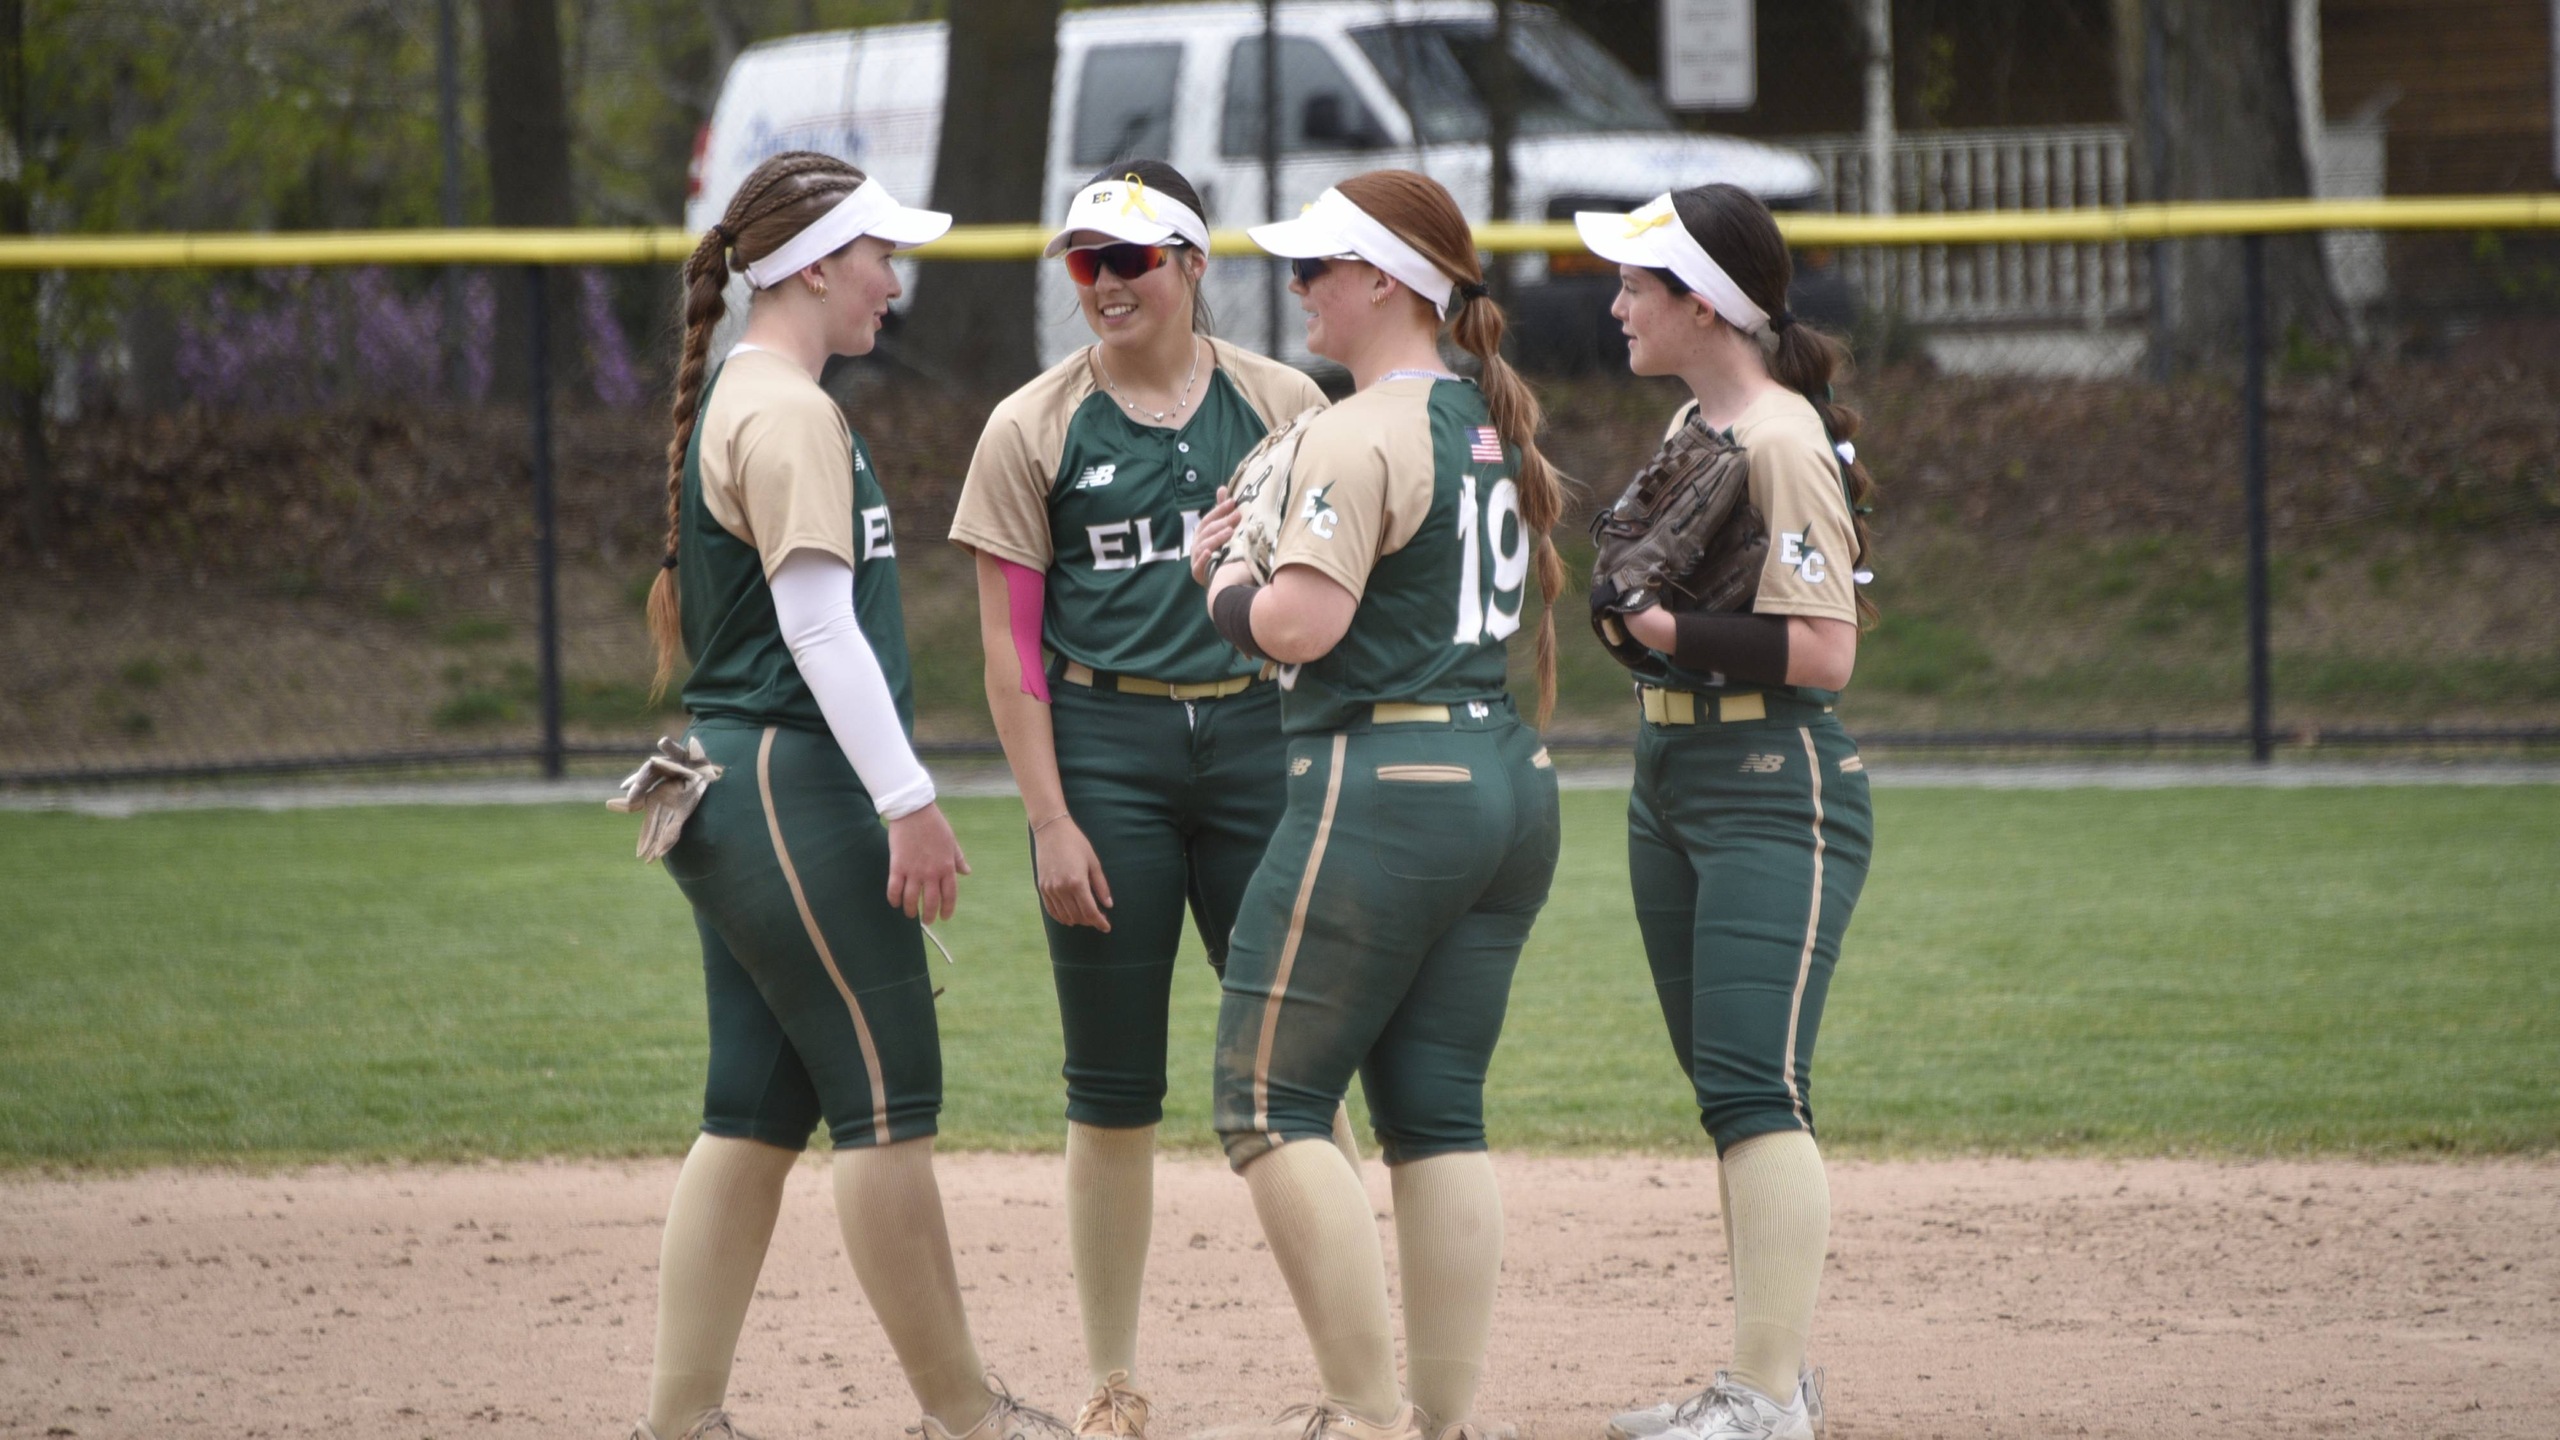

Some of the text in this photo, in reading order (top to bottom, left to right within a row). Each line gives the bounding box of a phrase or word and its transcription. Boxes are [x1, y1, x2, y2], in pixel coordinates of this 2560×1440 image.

[1091, 191, 1113, 205] EC
[1453, 474, 1530, 643] 19
[1780, 531, 1826, 584] EC
